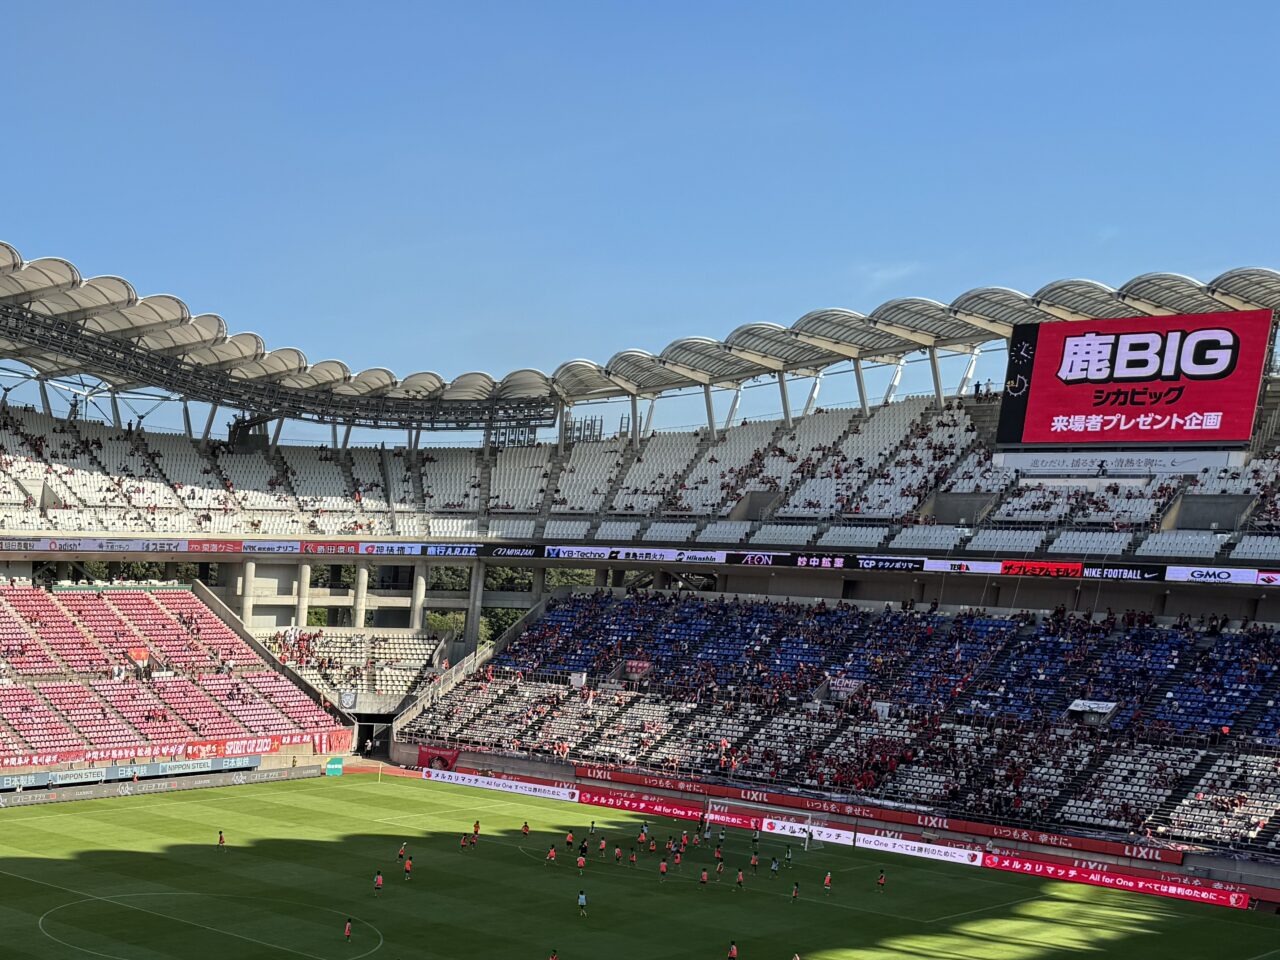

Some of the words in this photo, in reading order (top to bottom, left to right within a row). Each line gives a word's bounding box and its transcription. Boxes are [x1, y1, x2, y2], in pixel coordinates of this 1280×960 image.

[1057, 328, 1238, 383] 鹿BIG
[1092, 386, 1185, 407] シカビック
[1051, 412, 1223, 432] 来場者プレゼント企画
[858, 559, 876, 568] TCP
[1083, 567, 1102, 578] NIKE
[1103, 567, 1142, 580] FOOTBALL
[1190, 569, 1231, 580] GMO
[829, 678, 860, 689] HOME
[434, 773, 479, 785] メルカリマッチ
[587, 768, 612, 780] LIXIL
[740, 789, 769, 802] LIXIL
[592, 795, 646, 810] メルカリマッチ
[673, 807, 685, 816] One
[917, 815, 949, 829] LIXIL
[873, 839, 889, 848] One
[1124, 845, 1162, 860] LIXIL
[1001, 859, 1078, 877] メルカリマッチ
[1101, 874, 1114, 884] for
[1115, 877, 1134, 888] One
